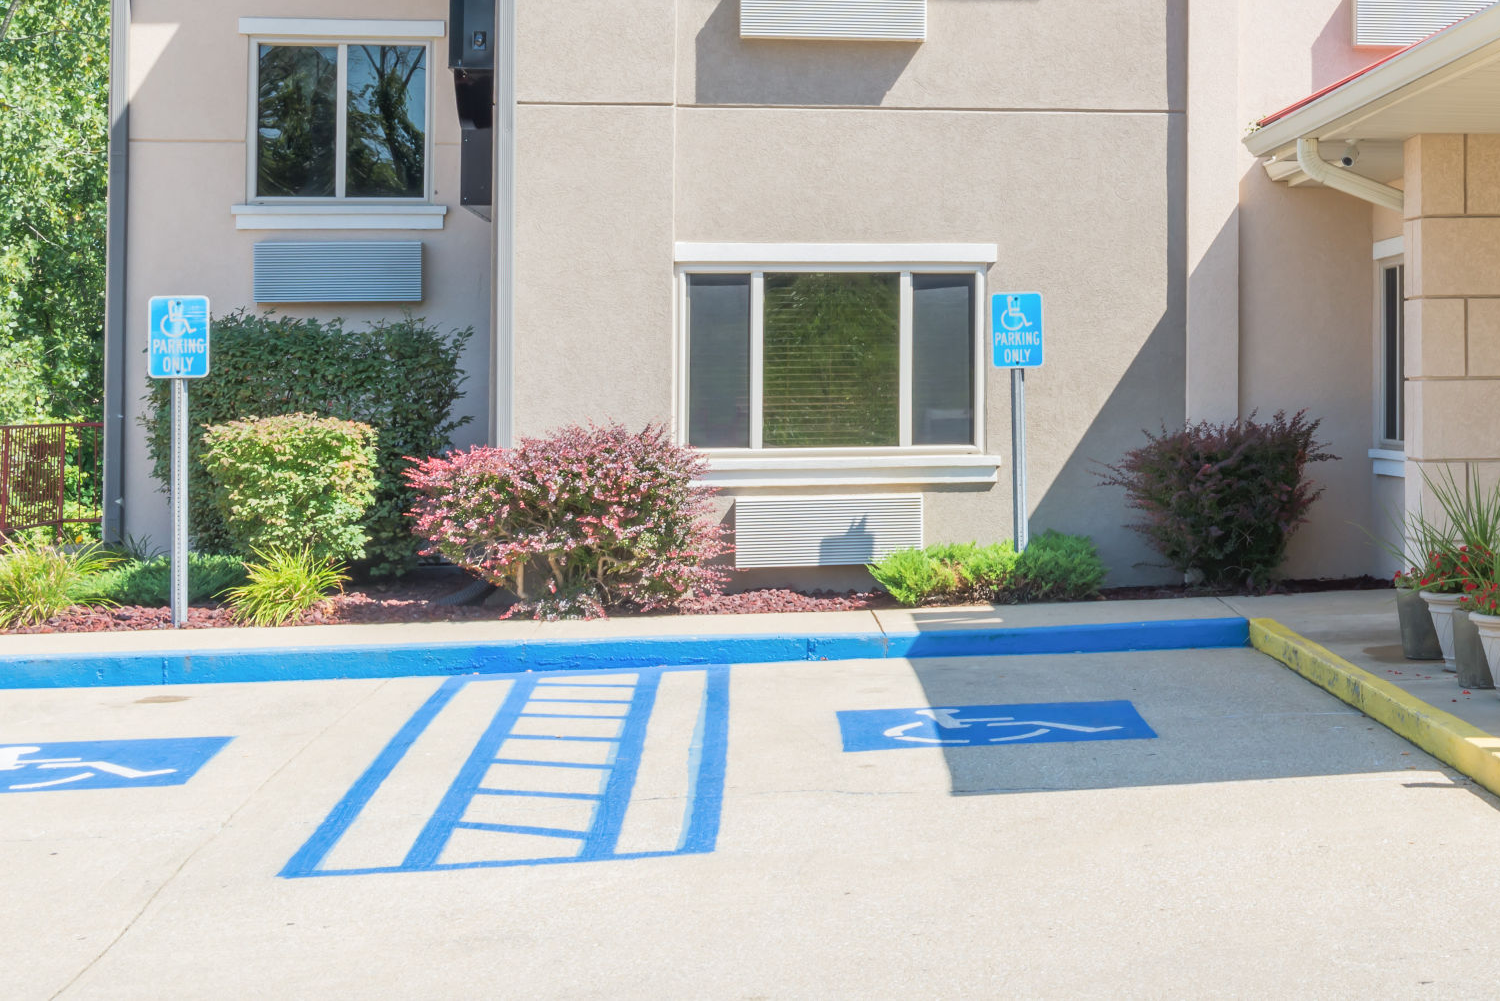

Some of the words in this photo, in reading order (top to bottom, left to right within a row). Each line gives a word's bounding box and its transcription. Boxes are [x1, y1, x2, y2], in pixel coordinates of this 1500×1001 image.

[153, 338, 205, 355] PARKING
[995, 331, 1040, 347] PARKING
[1004, 348, 1031, 363] ONLY
[163, 356, 194, 373] ONLY
